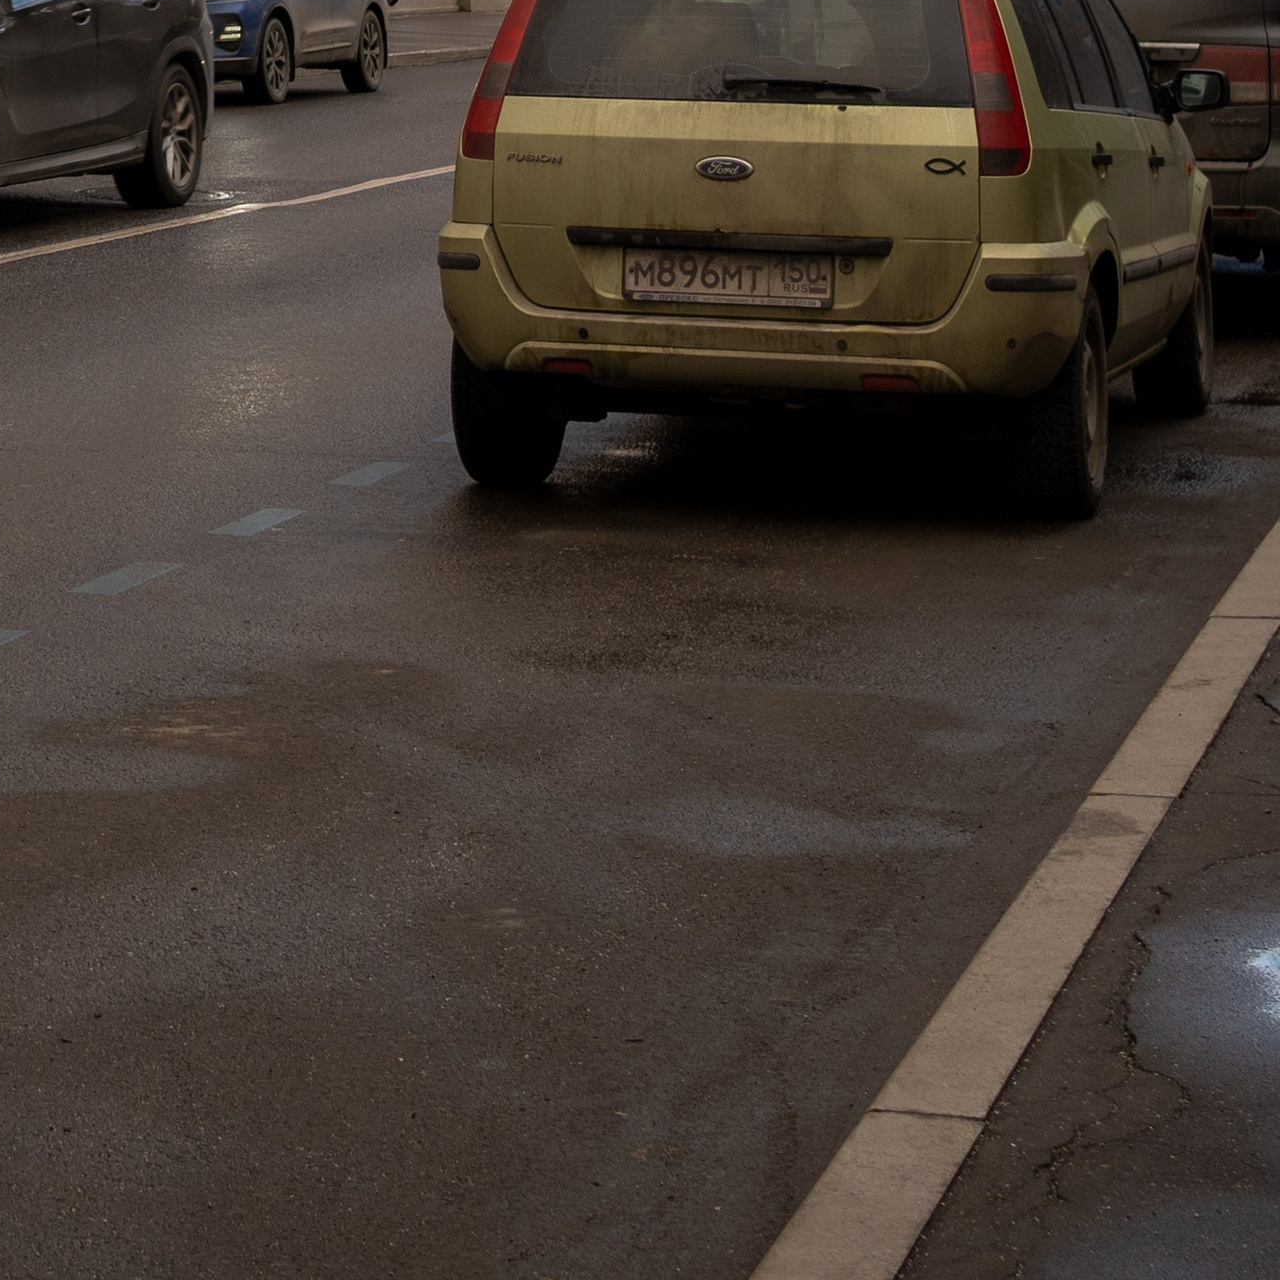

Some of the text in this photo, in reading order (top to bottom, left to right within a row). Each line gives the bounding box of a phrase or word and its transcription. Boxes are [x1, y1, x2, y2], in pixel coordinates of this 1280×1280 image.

[506, 151, 563, 165] FUSION
[706, 160, 741, 176] Ford
[633, 253, 821, 291] М896МТ 150
[783, 283, 809, 293] RUS
